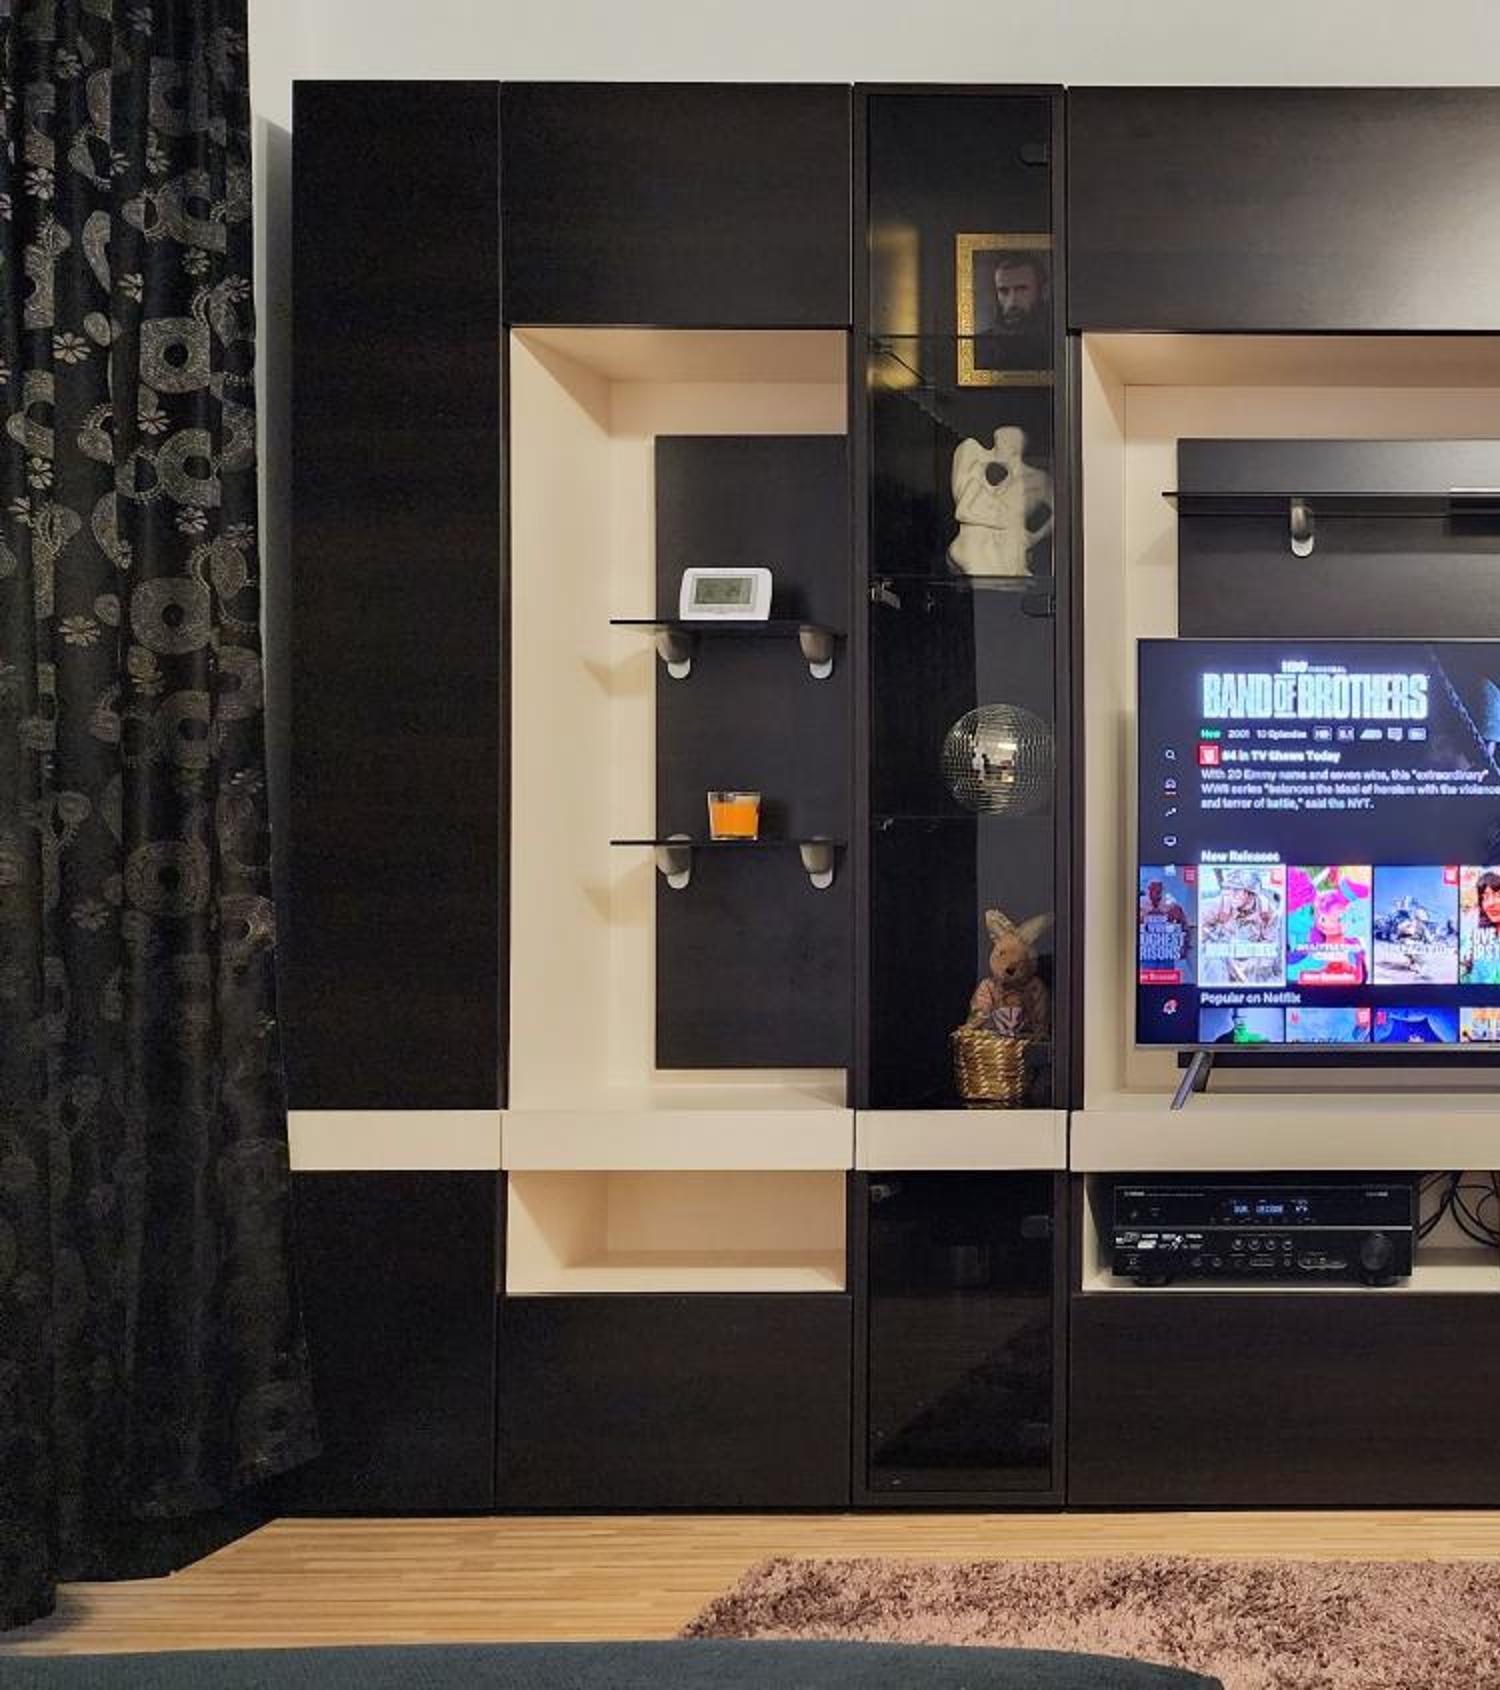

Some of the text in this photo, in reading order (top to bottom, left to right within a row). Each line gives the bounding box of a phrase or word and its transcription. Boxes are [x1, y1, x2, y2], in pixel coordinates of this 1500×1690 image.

[1202, 672, 1429, 719] BAND OF BROTHERS
[1200, 729, 1221, 739] New
[1227, 729, 1251, 739] 2001
[1268, 729, 1308, 740] Episodes
[1238, 749, 1250, 762] in
[1250, 749, 1267, 762] TV
[1268, 749, 1305, 762] Shows
[1305, 749, 1341, 764] Today
[1201, 769, 1226, 780] With
[1244, 769, 1277, 782] Emmy
[1309, 769, 1329, 780] and
[1329, 771, 1362, 780] seven
[1391, 769, 1411, 780] this
[1231, 783, 1263, 795] series
[1315, 783, 1333, 795] the
[1335, 784, 1361, 795] ideal
[1361, 784, 1373, 795] of
[1373, 784, 1416, 795] heroism
[1417, 784, 1439, 795] with
[1439, 784, 1457, 795] the
[1201, 797, 1221, 809] and
[1222, 797, 1253, 809] terror
[1253, 797, 1266, 809] of
[1305, 797, 1327, 809] said
[1328, 797, 1346, 809] the
[1347, 797, 1375, 809] NYT.
[1201, 850, 1281, 862] New Releases
[1140, 946, 1180, 961] RISONS
[1201, 992, 1301, 1005] Popular on Netflix
